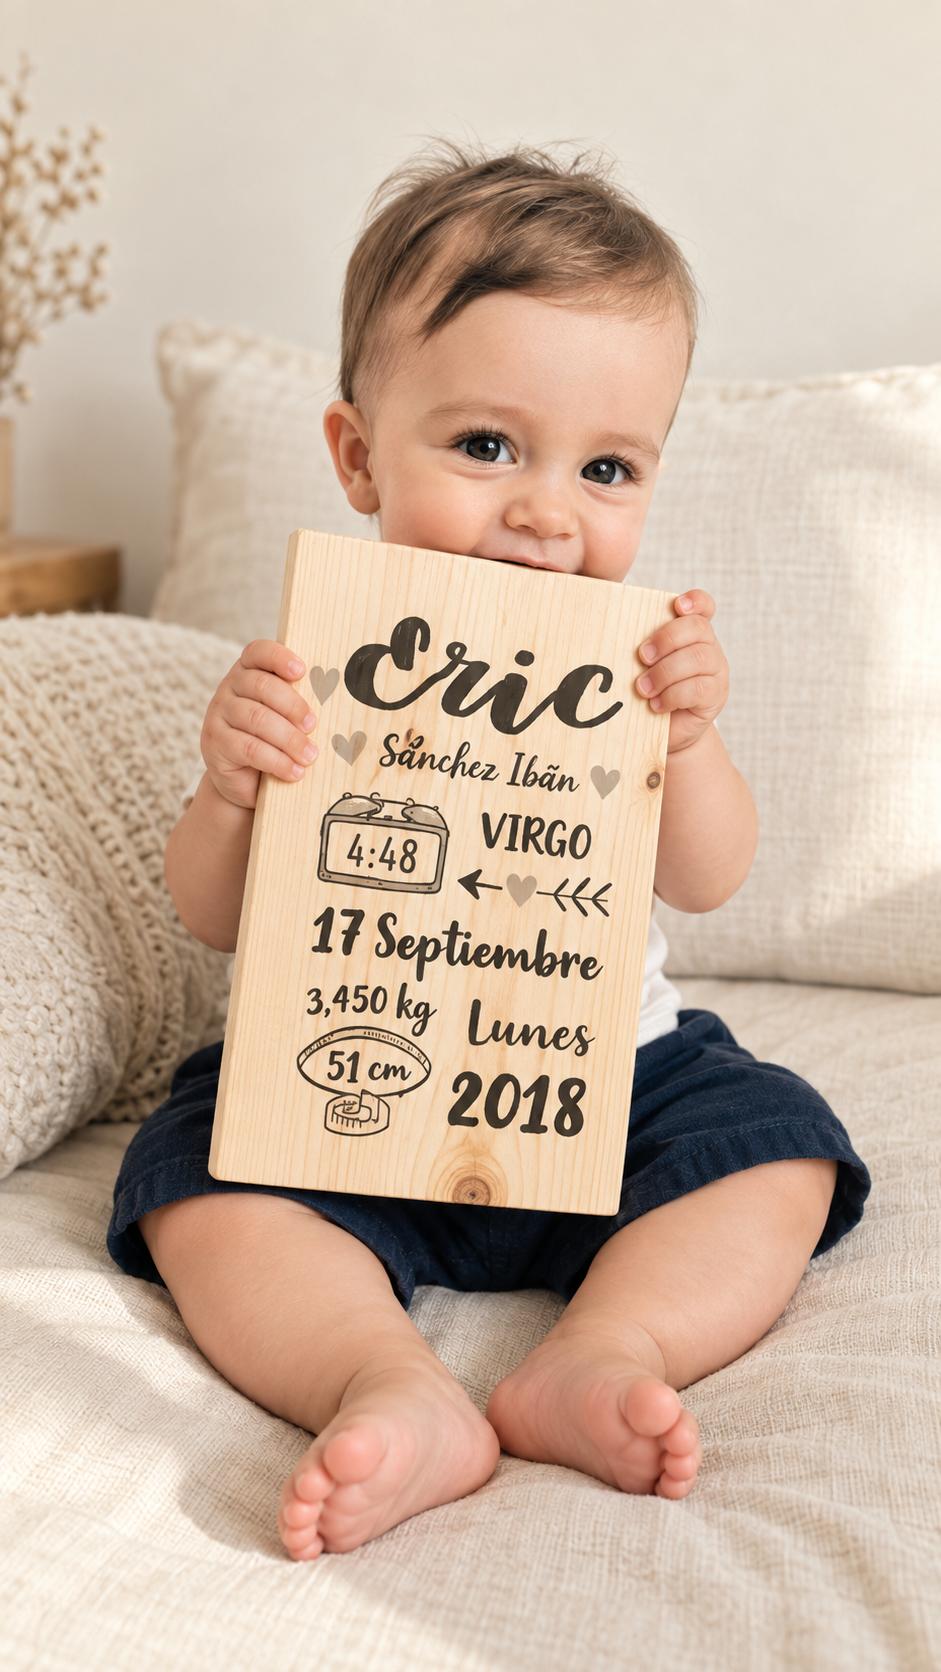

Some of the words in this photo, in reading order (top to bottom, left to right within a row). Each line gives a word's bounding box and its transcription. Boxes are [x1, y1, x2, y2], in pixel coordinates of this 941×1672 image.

[343, 615, 624, 735] Eric
[346, 833, 418, 874] 4:48
[481, 812, 592, 860] VIRGO
[312, 906, 365, 956] 17
[374, 911, 603, 982] Septiembre
[306, 984, 388, 1018] 3,450
[395, 982, 438, 1036] kg
[468, 998, 596, 1057] Lunes
[326, 1050, 360, 1084] 51
[368, 1062, 412, 1081] cm
[447, 1071, 587, 1138] 2018
